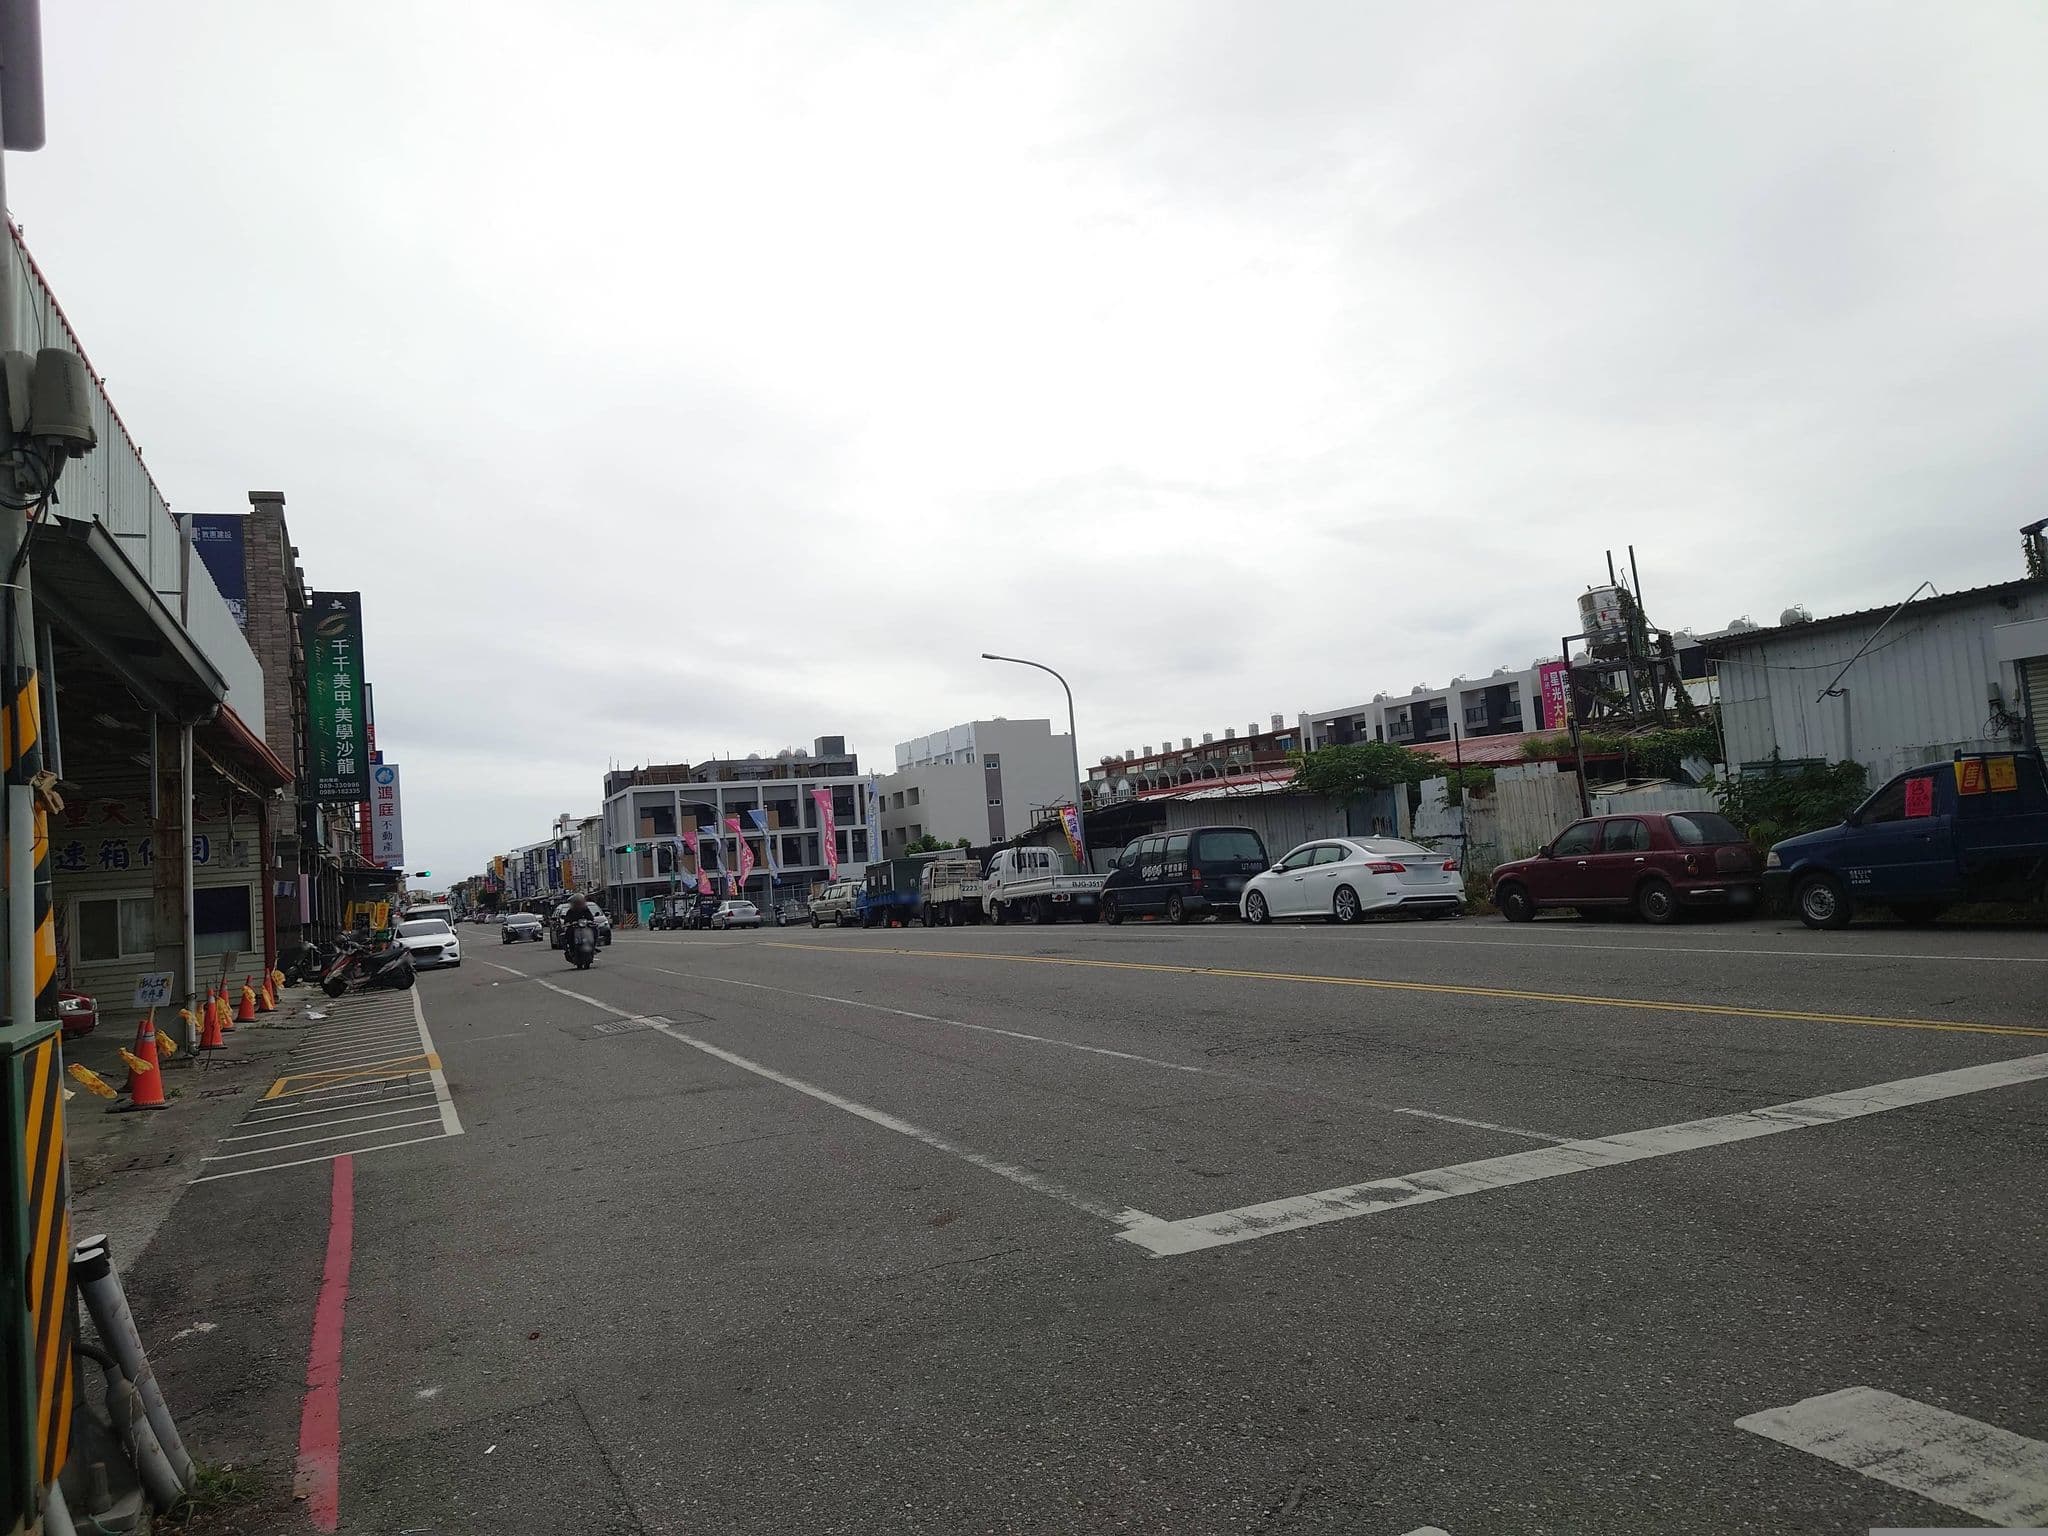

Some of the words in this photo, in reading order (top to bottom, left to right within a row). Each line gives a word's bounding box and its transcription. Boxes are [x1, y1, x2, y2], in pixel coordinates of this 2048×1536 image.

[331, 639, 355, 775] 千千美甲美學沙龍
